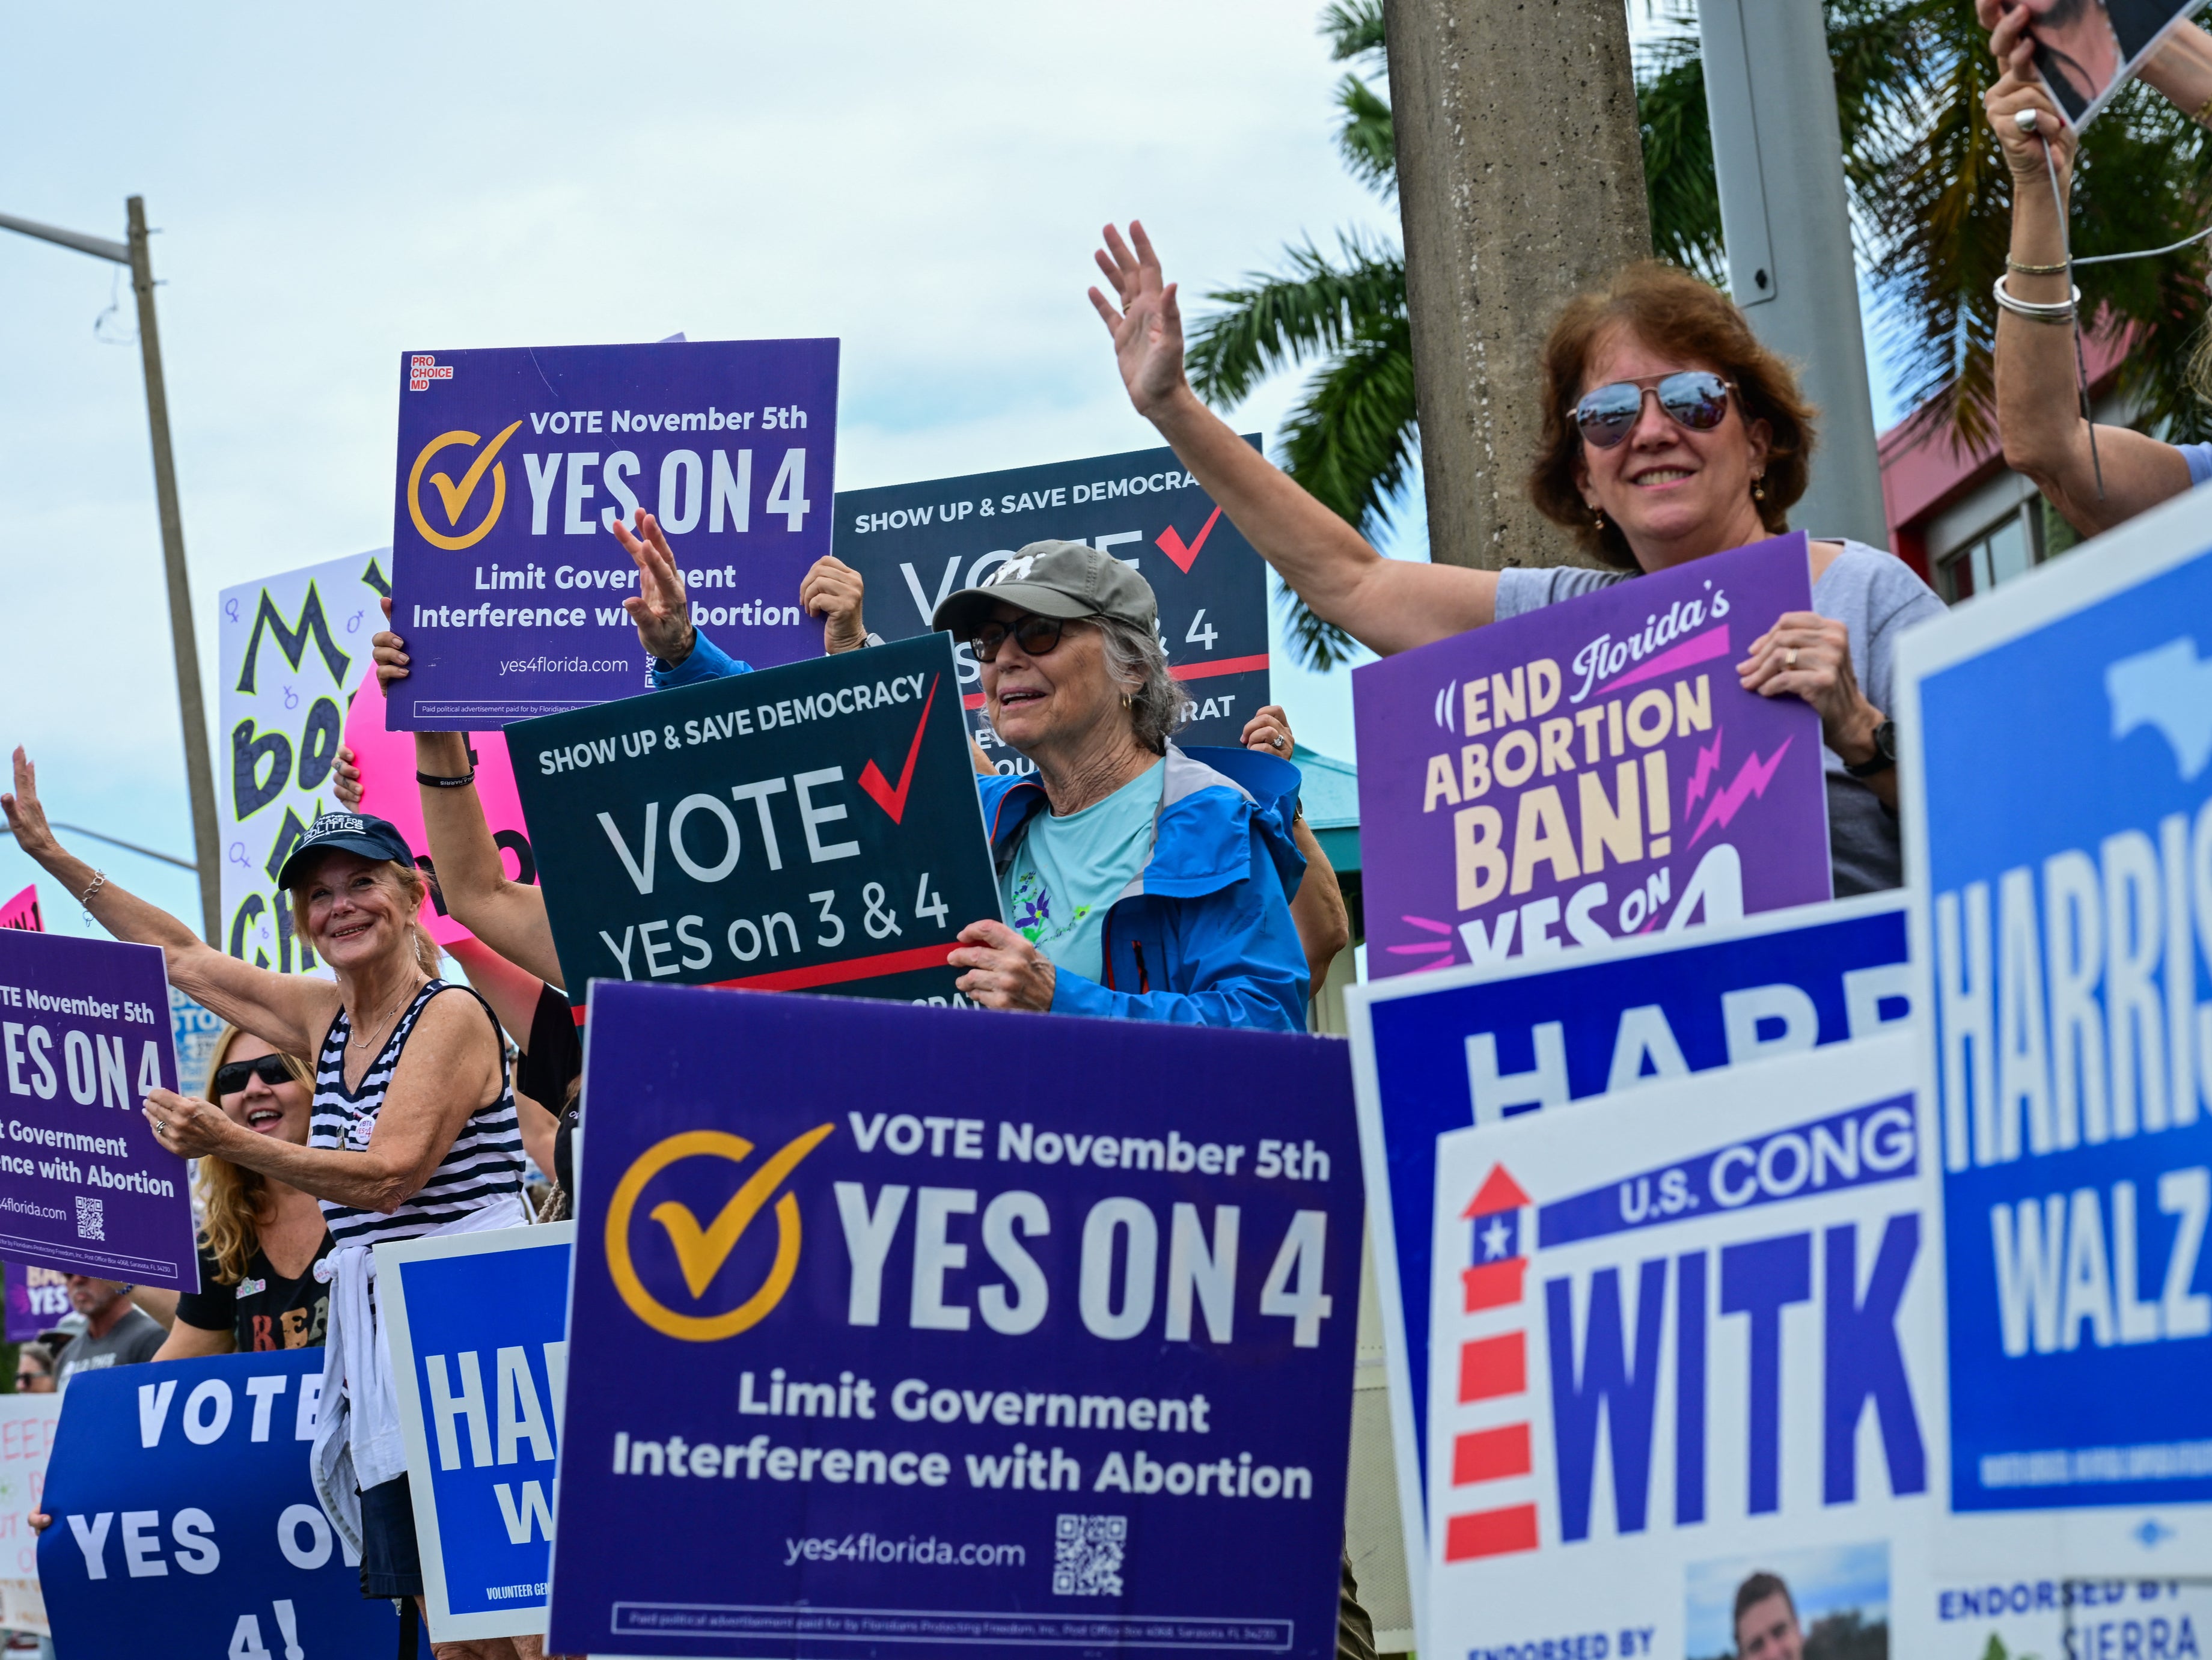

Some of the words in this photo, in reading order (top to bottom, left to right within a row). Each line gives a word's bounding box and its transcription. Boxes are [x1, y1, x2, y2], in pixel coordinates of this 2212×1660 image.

[411, 368, 452, 378] CHOICE
[411, 380, 429, 389] MD
[412, 356, 434, 367] PRO
[530, 411, 602, 435] VOTE
[611, 407, 754, 433] November
[762, 405, 807, 430] 5th
[523, 450, 641, 536] YES
[659, 448, 753, 534] ON
[766, 448, 810, 532] 4
[854, 505, 933, 534] SHOW
[939, 501, 973, 522] UP
[979, 498, 995, 516] &
[1001, 488, 1066, 513] SAVE
[1073, 471, 1200, 504] DEMOCRA
[475, 564, 546, 590] Limit
[555, 565, 736, 590] Goverent
[413, 605, 586, 628] Interference
[691, 599, 800, 626] bortion
[1185, 609, 1218, 650] 4
[499, 656, 628, 676] yes4florida.com
[1462, 658, 1562, 737] END
[1569, 580, 1730, 703] Florida's
[436, 705, 460, 713] political
[506, 705, 519, 713] paid
[530, 705, 538, 713] by
[538, 737, 617, 776] SHOW
[623, 730, 657, 758] UP
[664, 727, 682, 749] &
[685, 709, 754, 745] SAVE
[759, 673, 925, 731] DEMOCRACY
[1423, 674, 1712, 813] ABORTION
[303, 822, 364, 844] POLITICS
[596, 766, 861, 896] VOTE
[1454, 749, 1672, 912] BAN!
[1619, 867, 1671, 933] ON
[599, 915, 713, 982] YES
[727, 912, 800, 962] on
[808, 889, 845, 948] 3
[862, 882, 902, 940] &
[915, 873, 949, 929] 4
[0, 986, 22, 1007] TE
[25, 989, 120, 1022] November
[124, 1001, 154, 1025] 5th
[3, 1021, 58, 1100] ES
[65, 1030, 130, 1111] ON
[137, 1041, 162, 1097] 4
[8, 1120, 128, 1158] Government
[849, 1112, 983, 1160] VOTE
[998, 1122, 1244, 1176] November
[1255, 1140, 1330, 1182] 5th
[1619, 1170, 1699, 1224] U.S.
[1708, 1106, 1916, 1210] CONG
[38, 1156, 82, 1185] with
[87, 1165, 174, 1198] Abortion
[834, 1182, 1051, 1336] YES
[1081, 1197, 1240, 1344] ON
[1259, 1210, 1332, 1349] 4
[28, 1285, 70, 1316] YES
[739, 1369, 875, 1419] Limit
[891, 1378, 1210, 1434] Government
[1544, 1208, 1929, 1546] WITK
[612, 1433, 950, 1487] Interference
[965, 1444, 1081, 1492] with
[1094, 1451, 1312, 1500] Abortion
[67, 1507, 221, 1580] YES
[784, 1533, 1026, 1567] yes4florida.com
[486, 1584, 533, 1600] VOLUNTEER
[1618, 1625, 1656, 1658] BY
